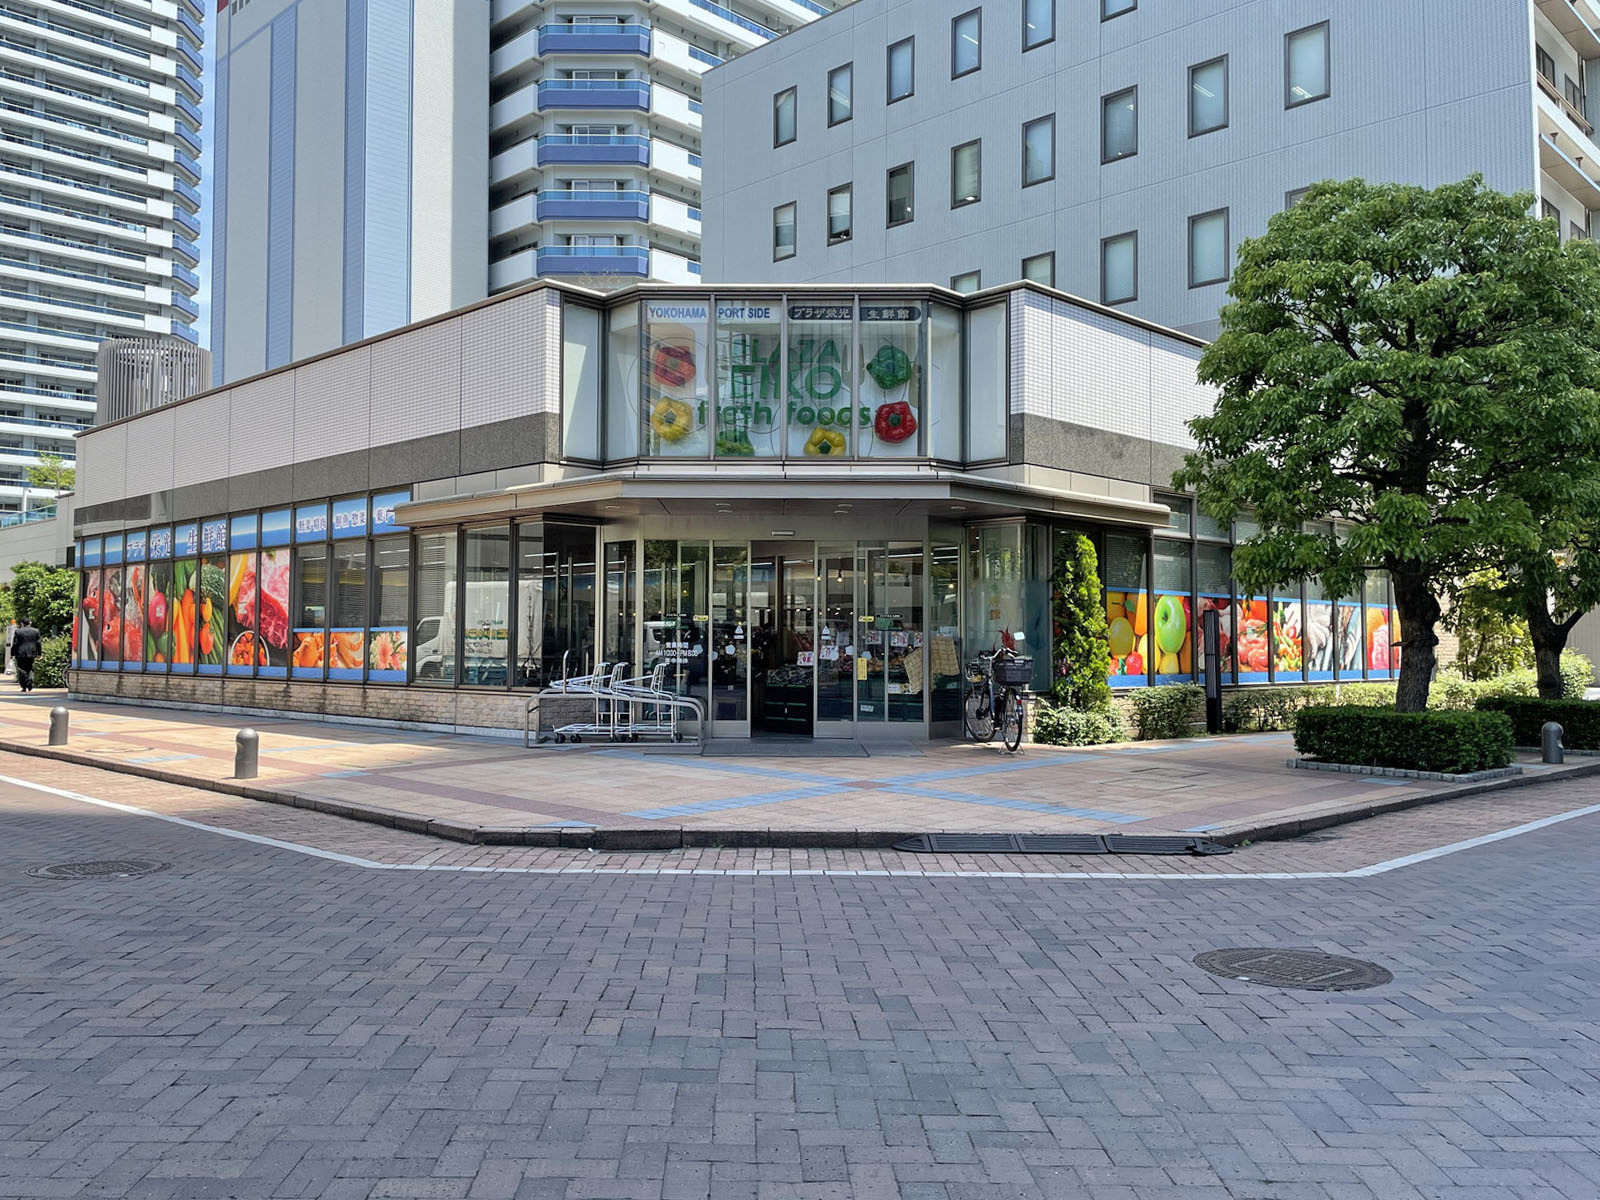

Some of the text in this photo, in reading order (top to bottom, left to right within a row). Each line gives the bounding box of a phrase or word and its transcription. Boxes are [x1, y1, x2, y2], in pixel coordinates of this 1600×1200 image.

[649, 307, 770, 318] YOKOHAMA PORT SIDE
[794, 307, 910, 320] プラザ栄光 生鮮館
[733, 339, 841, 363] LAZA
